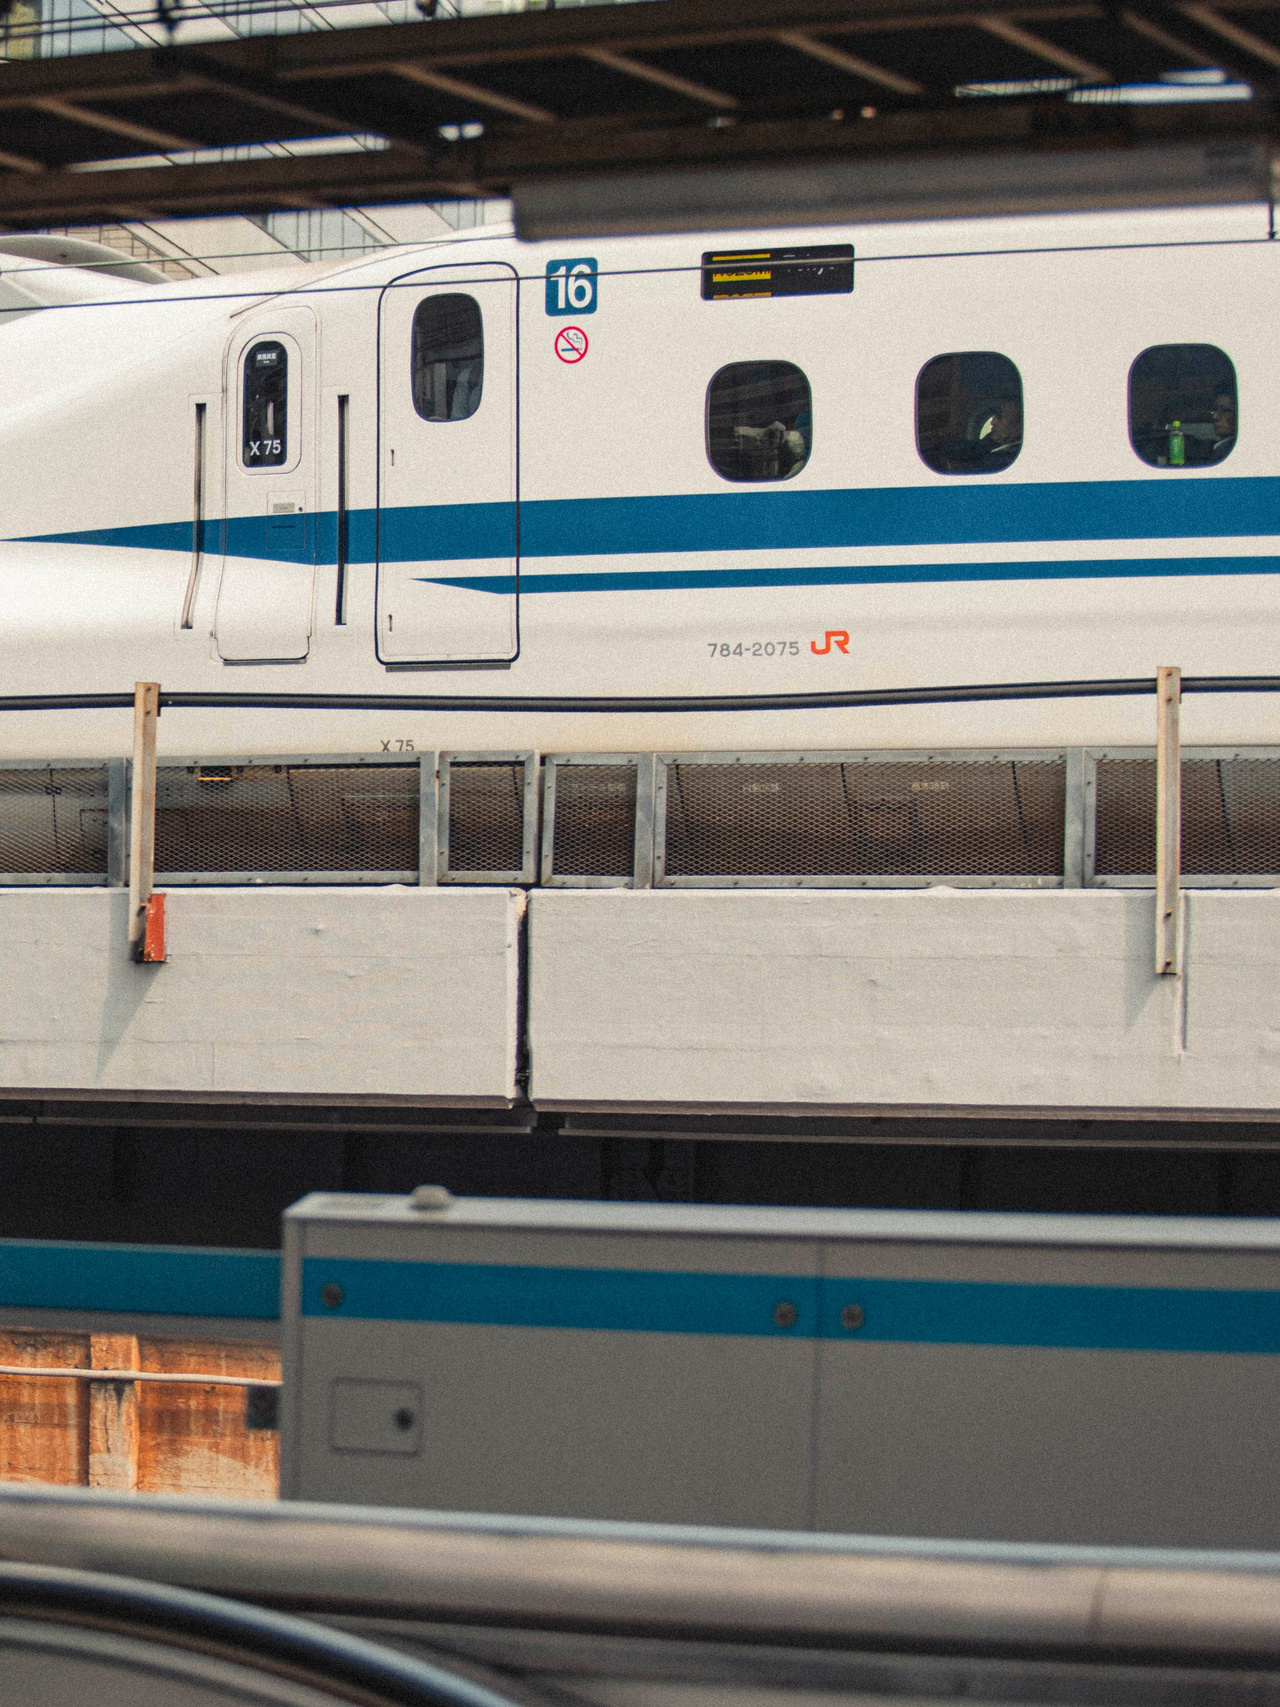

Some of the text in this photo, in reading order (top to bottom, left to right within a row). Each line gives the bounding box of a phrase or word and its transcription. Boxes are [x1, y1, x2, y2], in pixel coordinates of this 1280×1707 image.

[550, 264, 592, 309] 16
[249, 440, 282, 456] X 75
[707, 630, 850, 658] 784-2075 JR
[380, 739, 415, 752] X 75
